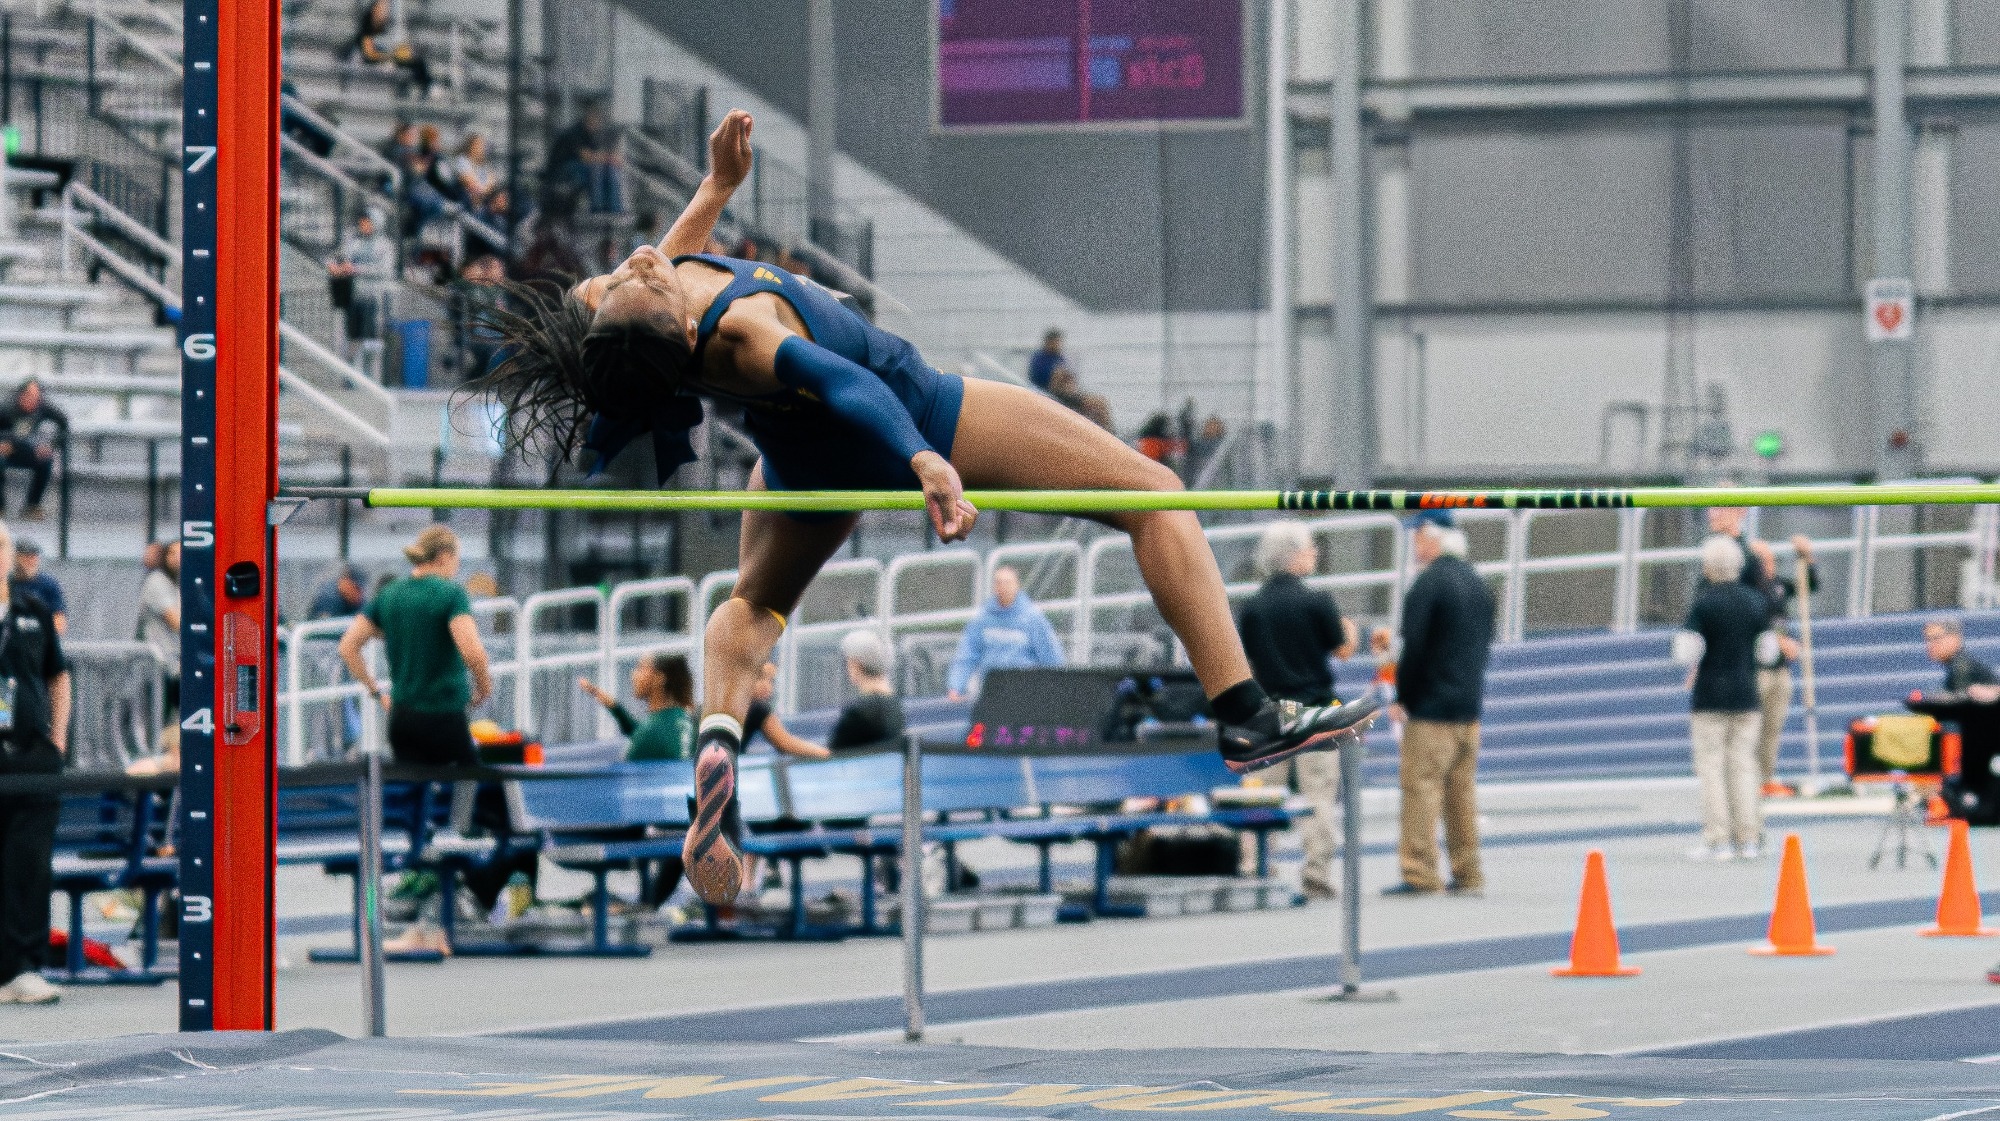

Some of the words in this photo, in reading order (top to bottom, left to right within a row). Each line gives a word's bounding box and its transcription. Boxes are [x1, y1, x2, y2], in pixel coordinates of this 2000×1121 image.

[186, 146, 216, 172] 7
[184, 334, 215, 359] 6
[183, 521, 214, 546] 5
[181, 708, 215, 734] 4
[183, 896, 211, 921] 3
